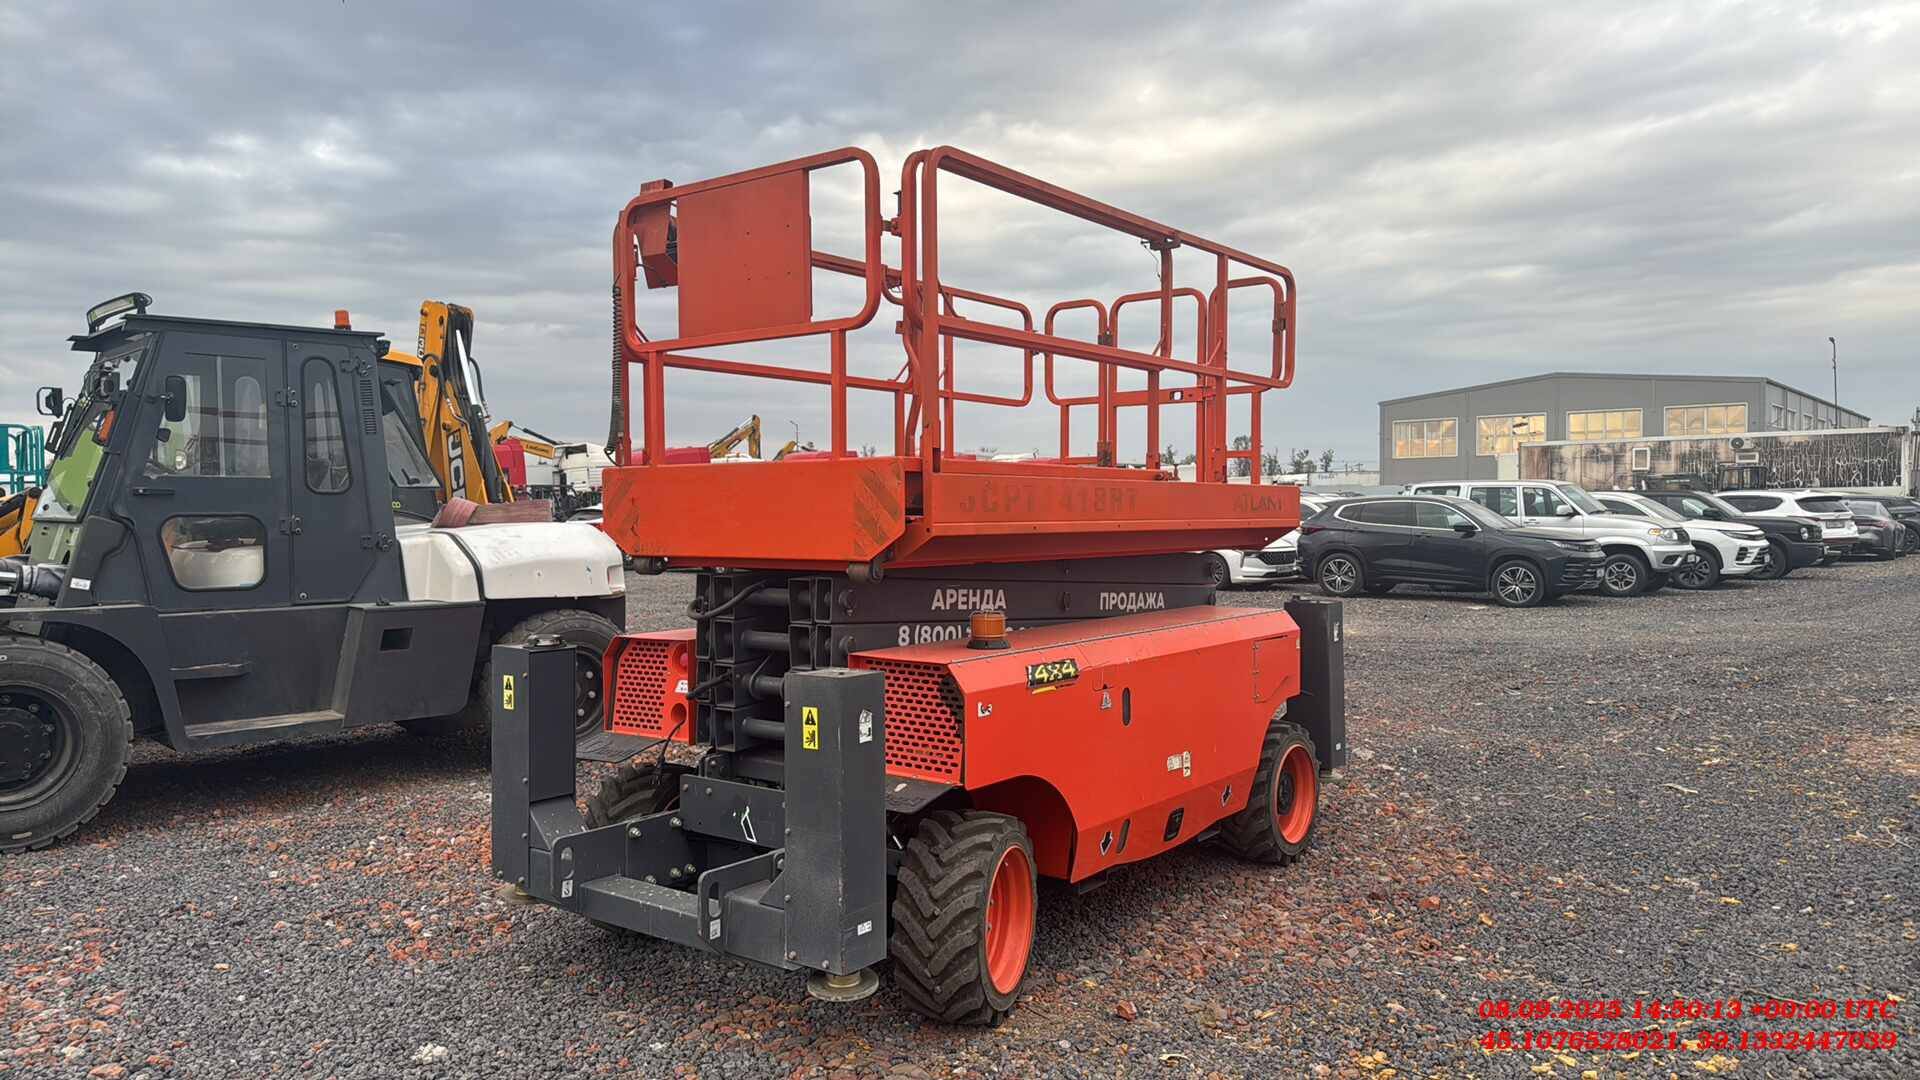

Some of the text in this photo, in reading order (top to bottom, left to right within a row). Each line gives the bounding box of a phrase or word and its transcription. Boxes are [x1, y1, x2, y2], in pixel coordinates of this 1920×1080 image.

[931, 588, 1007, 611] АРЕНДА
[1099, 591, 1165, 613] ПРОДАЖА
[897, 624, 911, 647] 8
